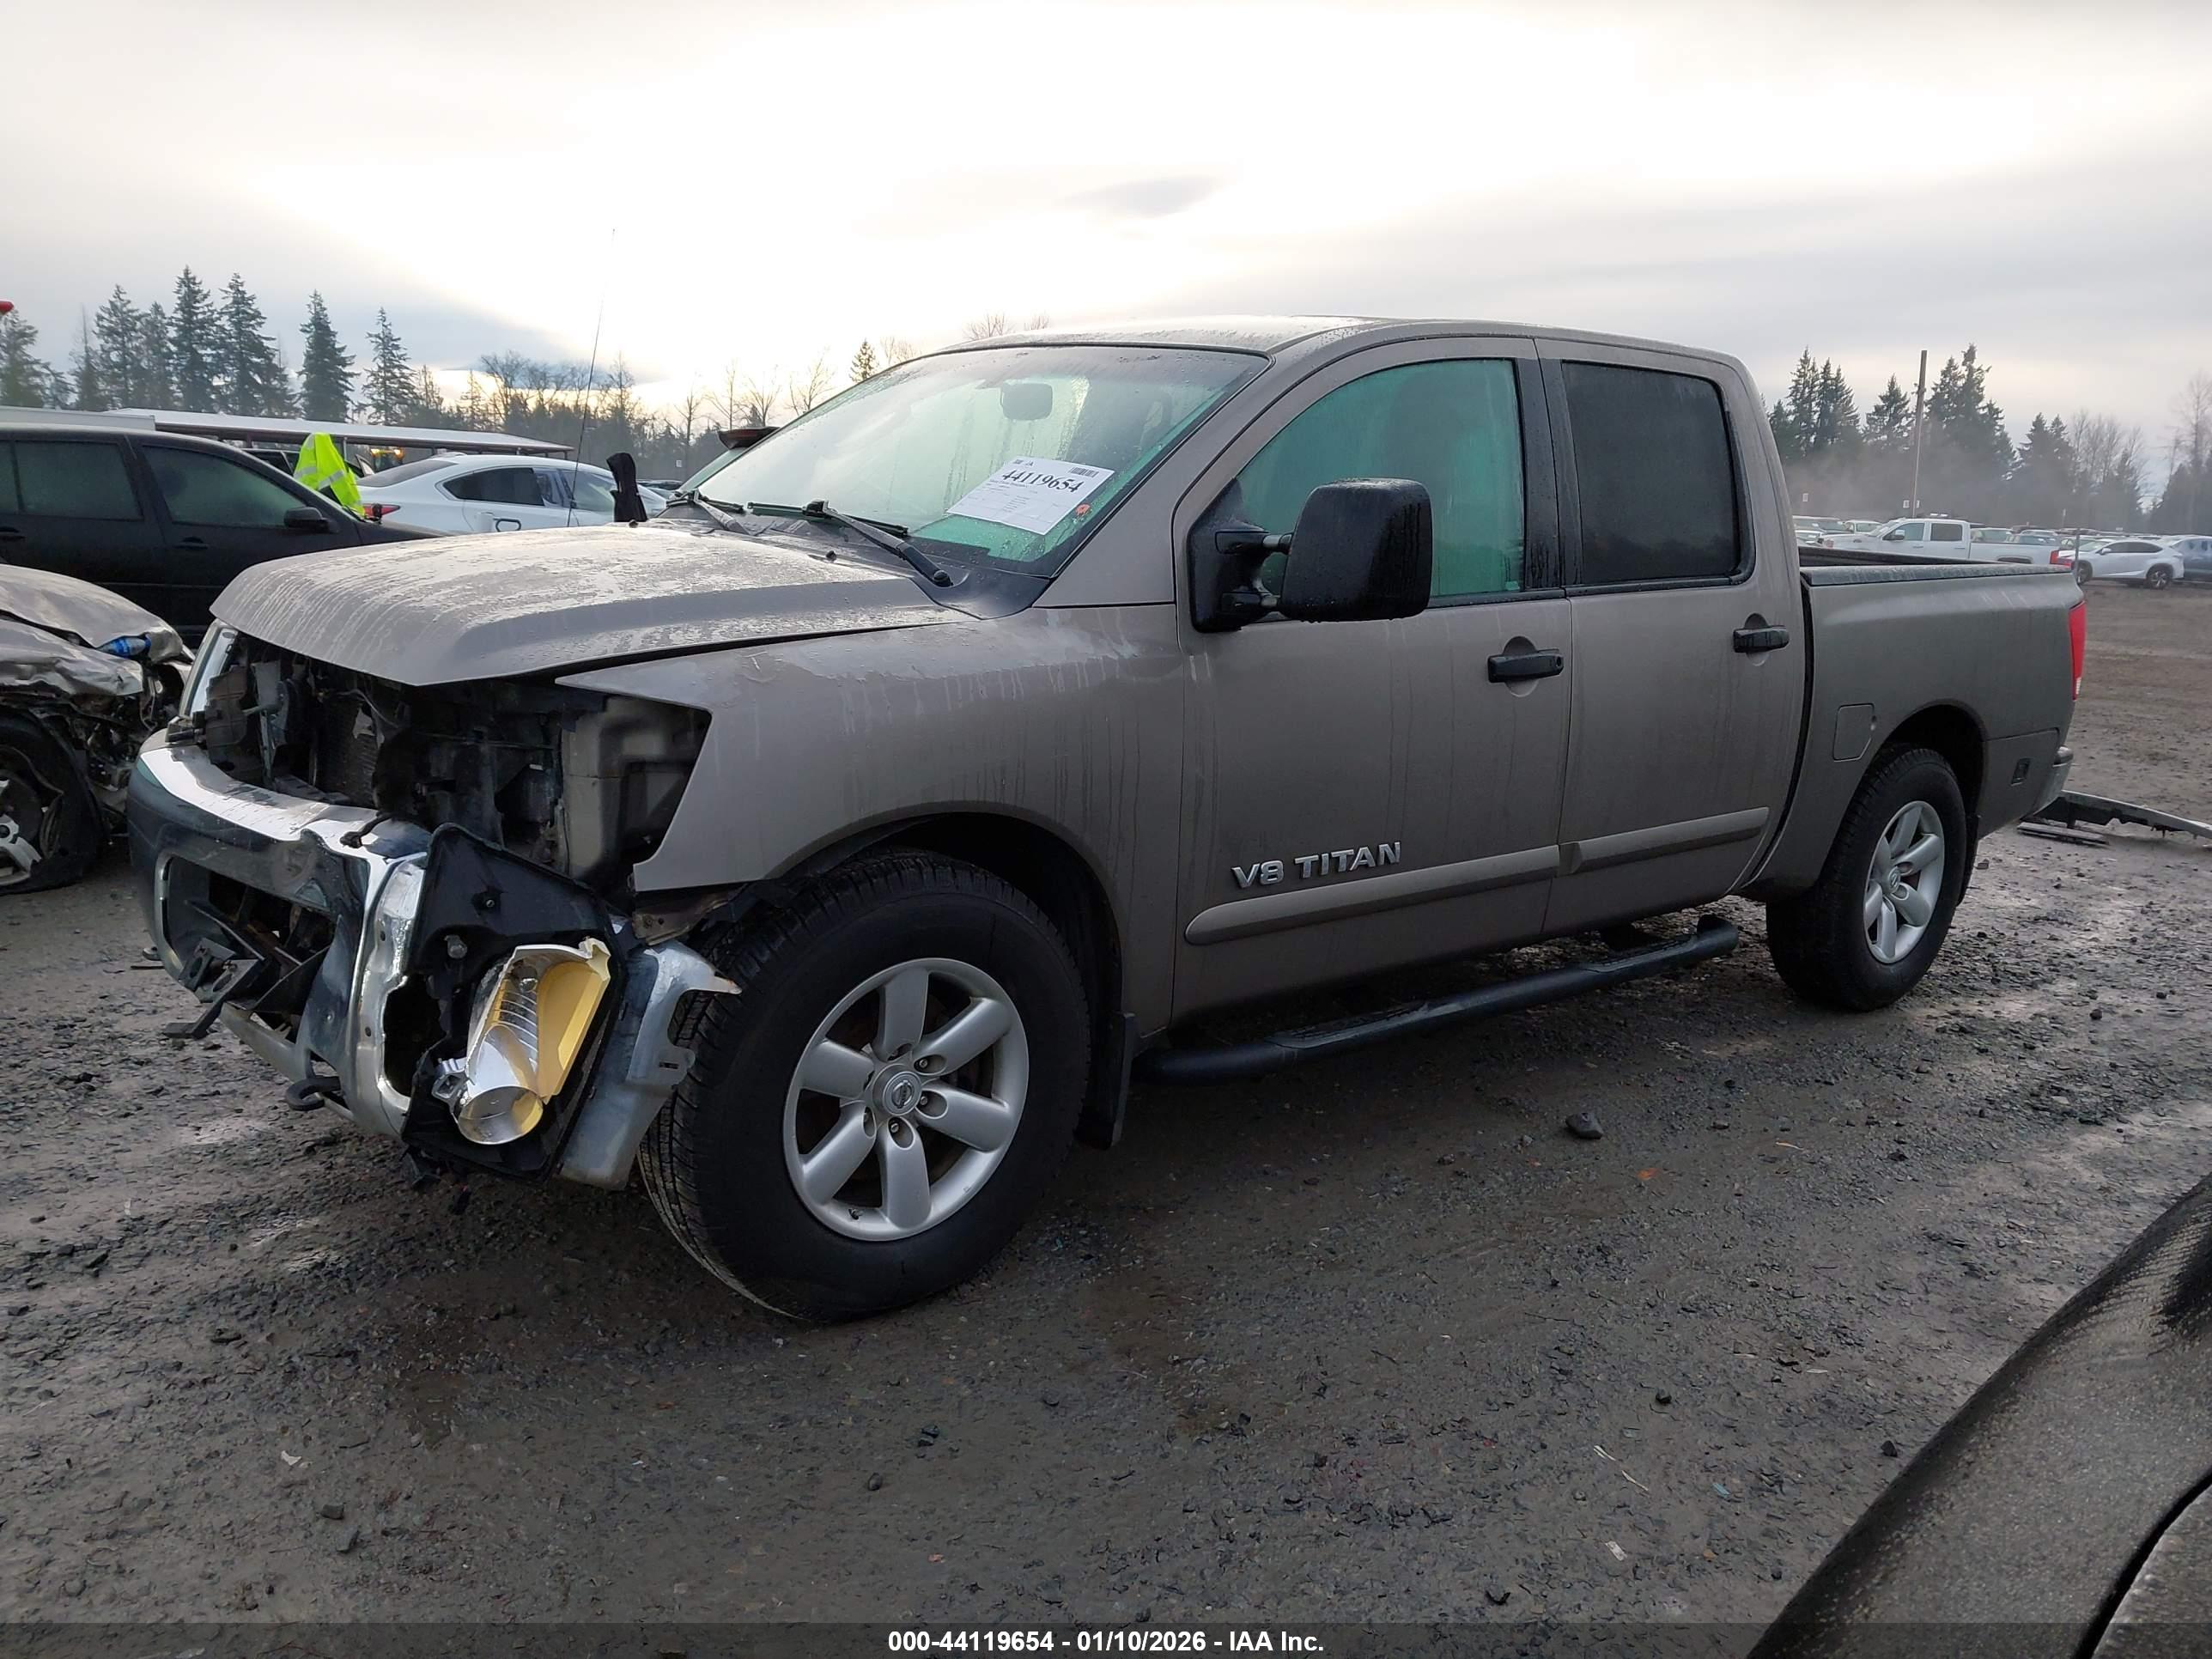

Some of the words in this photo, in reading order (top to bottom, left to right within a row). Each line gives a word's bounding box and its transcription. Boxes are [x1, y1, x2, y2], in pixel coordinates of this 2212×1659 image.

[1002, 469, 1085, 492] 44119654
[1231, 860, 1285, 889] V8
[1294, 842, 1401, 879] TITAN
